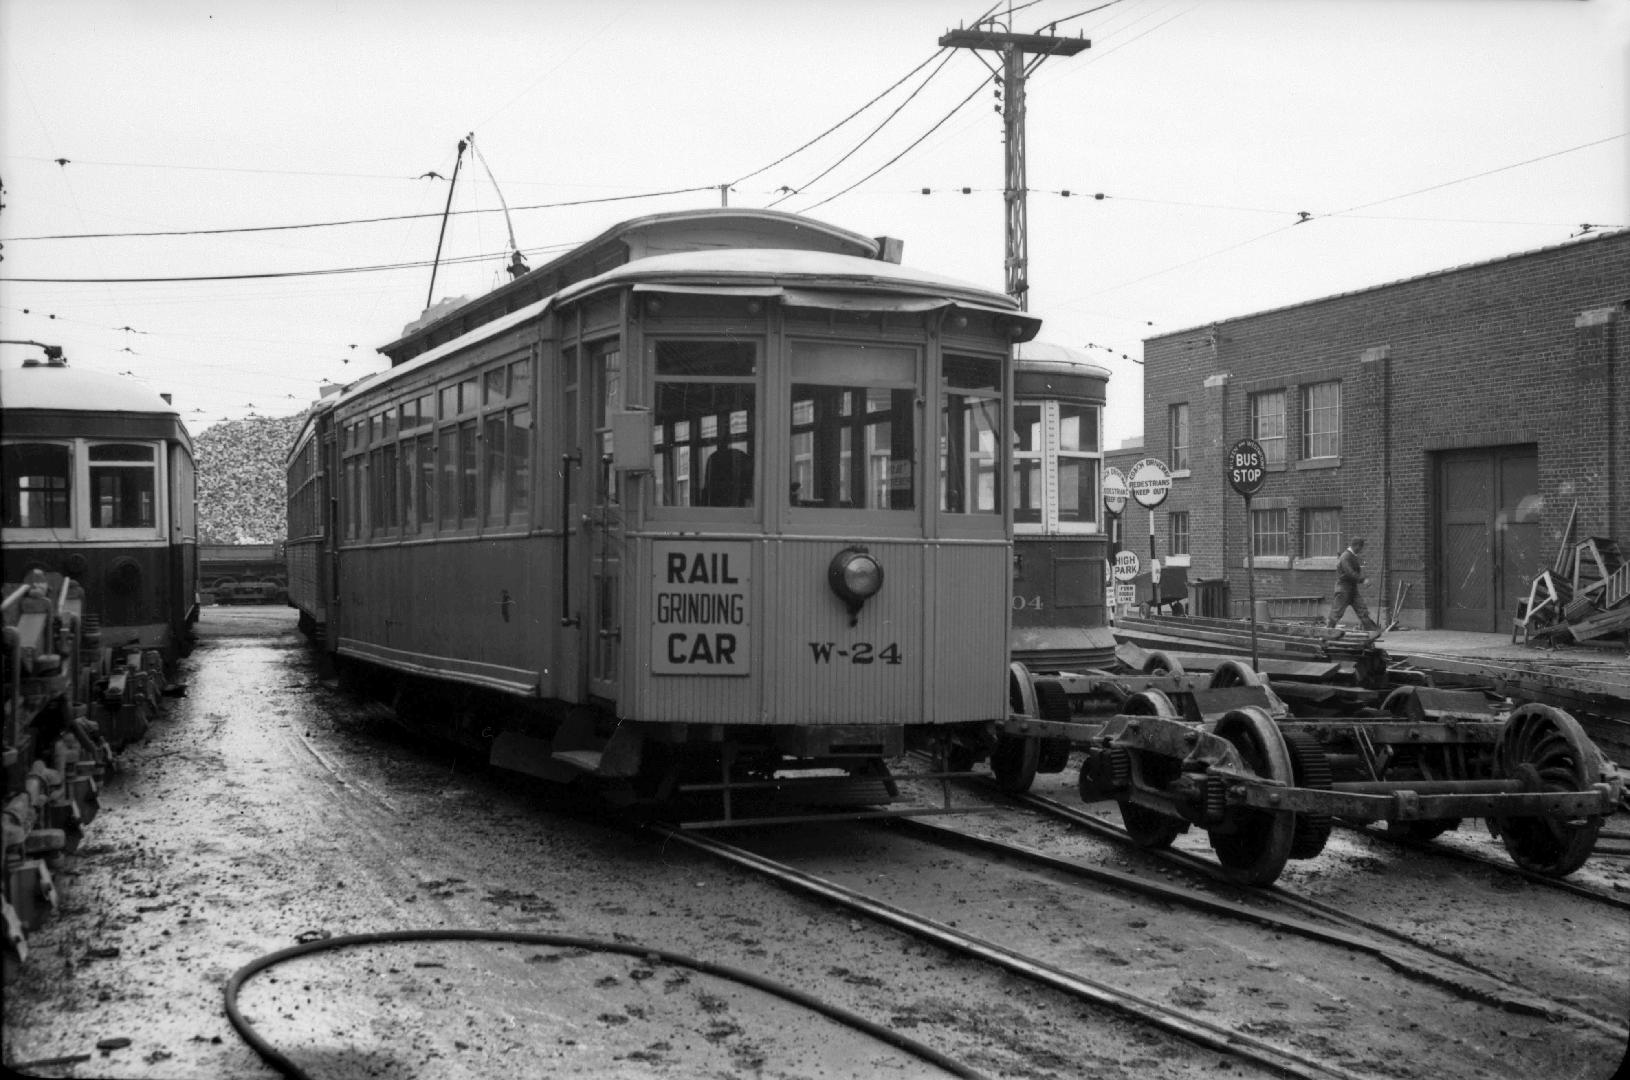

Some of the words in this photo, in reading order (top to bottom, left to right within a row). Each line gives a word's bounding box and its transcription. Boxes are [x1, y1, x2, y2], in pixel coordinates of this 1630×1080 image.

[1236, 453, 1258, 467] BUS
[1129, 462, 1145, 480] COACH
[1145, 459, 1170, 477] DRIVEWAY
[1233, 469, 1261, 482] STOP
[1129, 479, 1170, 488] PEDESTRIANS
[667, 552, 738, 584] RAIL
[1116, 556, 1136, 565] HIGH
[1115, 565, 1137, 575] PARK
[657, 592, 743, 625] GRINDING
[668, 633, 737, 665] CAR
[808, 642, 902, 665] W-24
